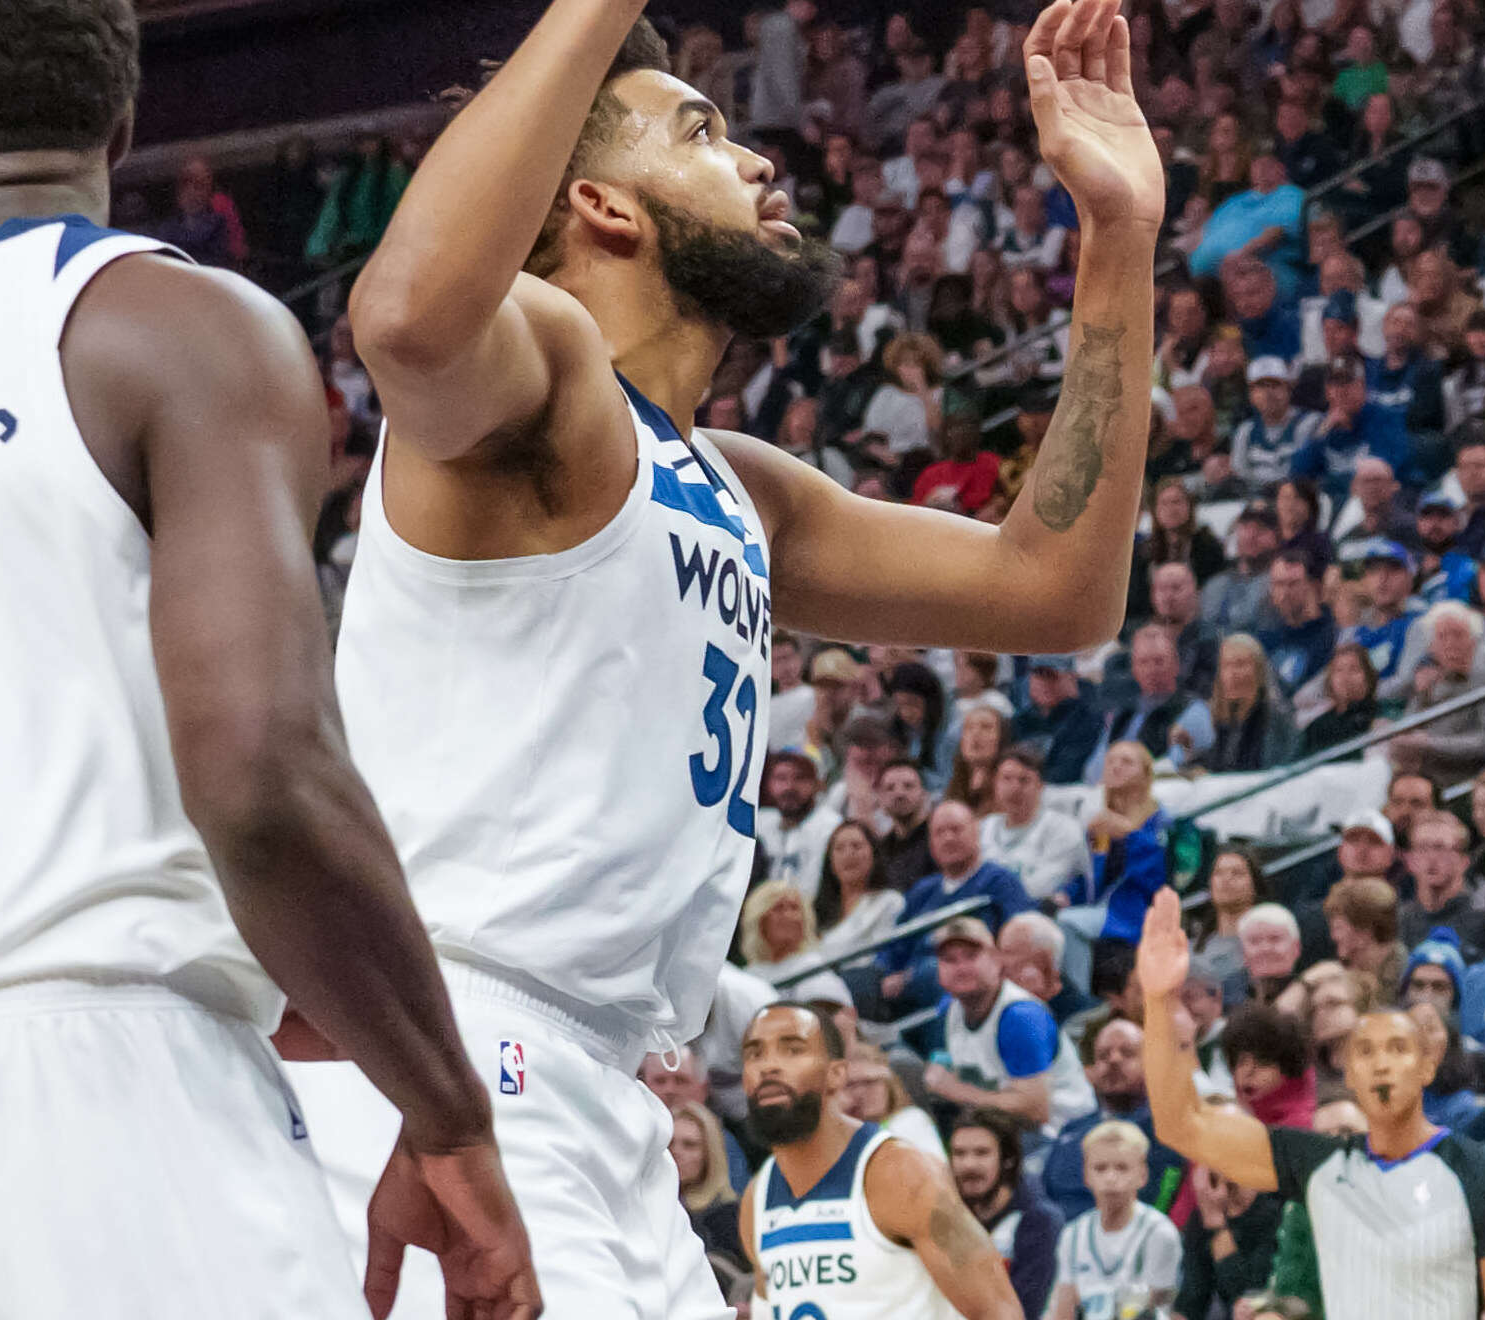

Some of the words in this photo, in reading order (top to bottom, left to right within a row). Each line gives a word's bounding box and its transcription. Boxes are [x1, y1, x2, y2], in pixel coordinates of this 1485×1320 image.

[669, 532, 772, 661] WOLVE
[688, 642, 756, 838] 32
[771, 1253, 857, 1290] OLVES
